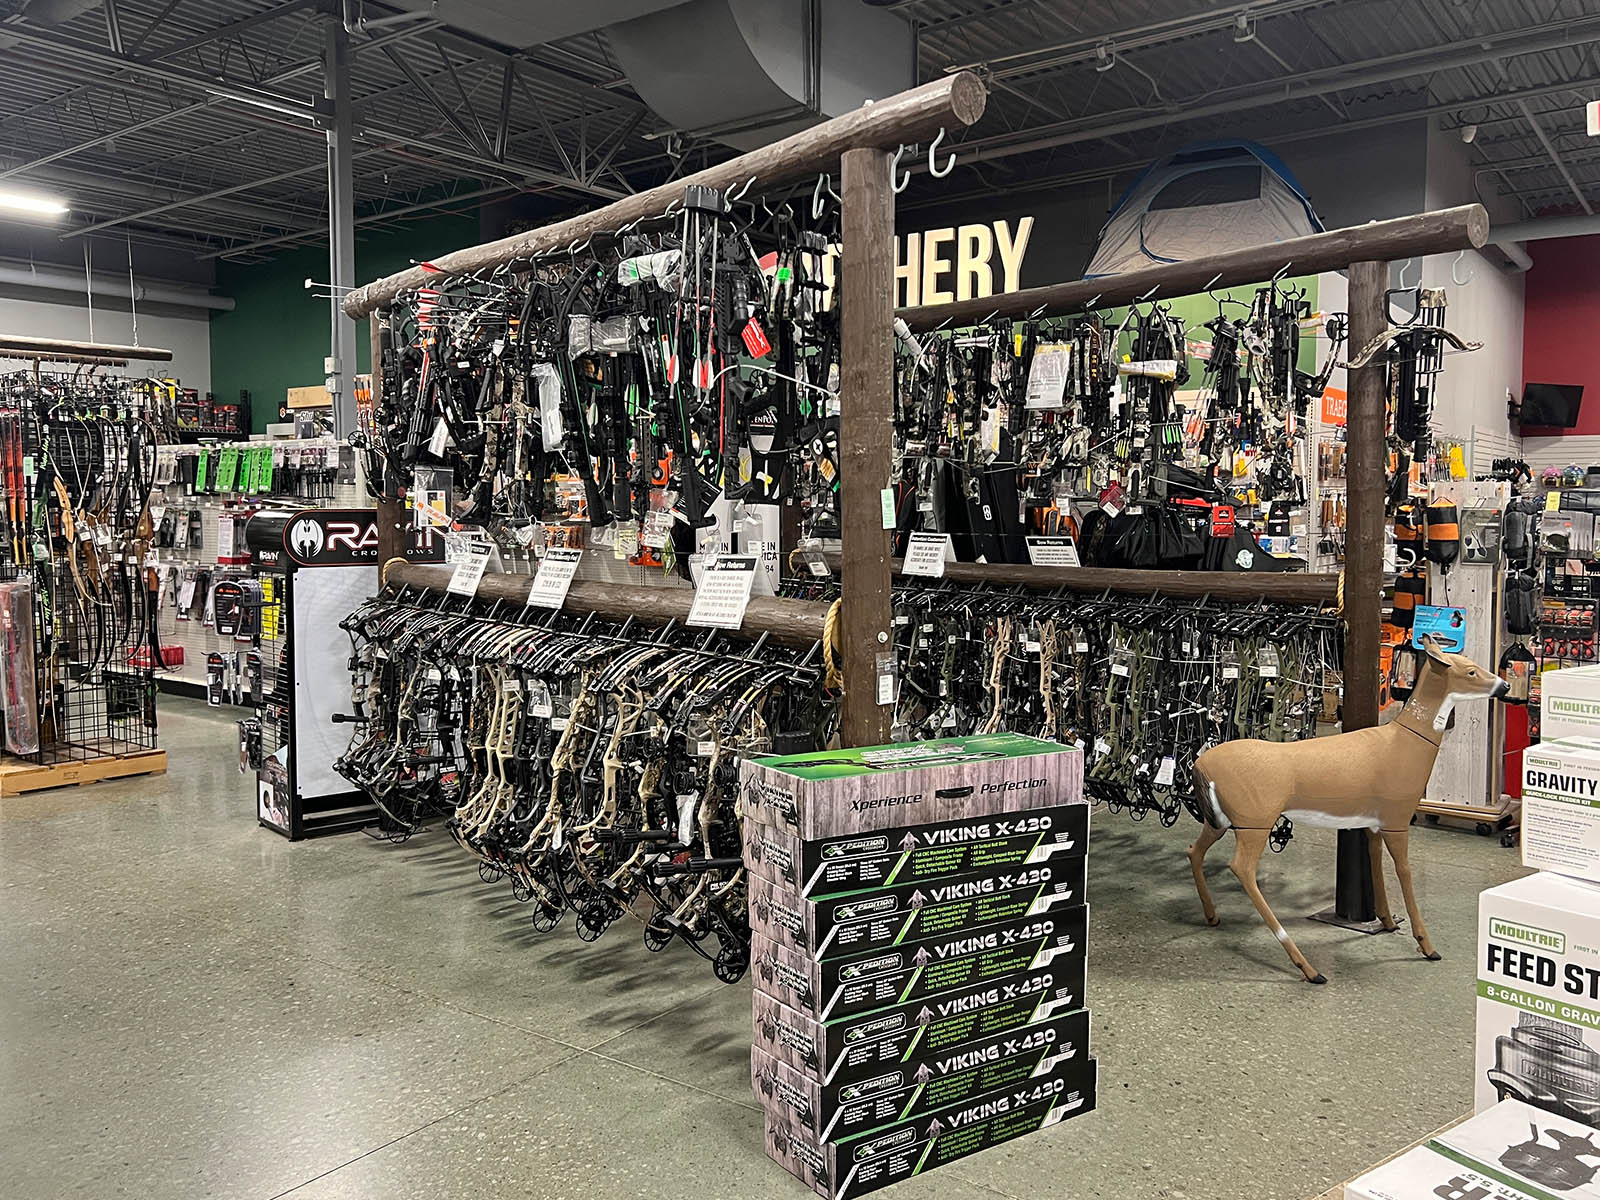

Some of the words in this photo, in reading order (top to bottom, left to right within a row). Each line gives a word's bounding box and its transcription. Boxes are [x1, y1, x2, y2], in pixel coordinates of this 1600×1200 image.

[326, 521, 448, 549] RAIN
[351, 548, 434, 558] CROOWS
[1529, 758, 1558, 767] MOULTRIE
[850, 793, 922, 813] Xperience
[980, 777, 1047, 795] Perfection
[1526, 770, 1598, 796] GRAVITY
[1526, 790, 1558, 801] QUICK-LOCK
[1559, 795, 1580, 805] FEEDER
[923, 824, 991, 845] VIKING
[995, 816, 1052, 836] X-430
[930, 878, 994, 902] VIKING
[998, 868, 1051, 890] X-430
[934, 932, 998, 958] VIKING
[1001, 921, 1054, 944] X-430
[1495, 923, 1560, 948] MOULTRIE
[1487, 943, 1556, 987] FEED
[1564, 963, 1600, 1000] ST
[937, 989, 999, 1016] VIKING
[1002, 974, 1053, 1000] X-430
[1487, 986, 1556, 1013] 8-GALLON
[936, 1044, 1000, 1075] VIKING
[1003, 1029, 1057, 1056] X-430
[947, 1097, 1010, 1128] VIKING
[1013, 1078, 1065, 1107] X-430
